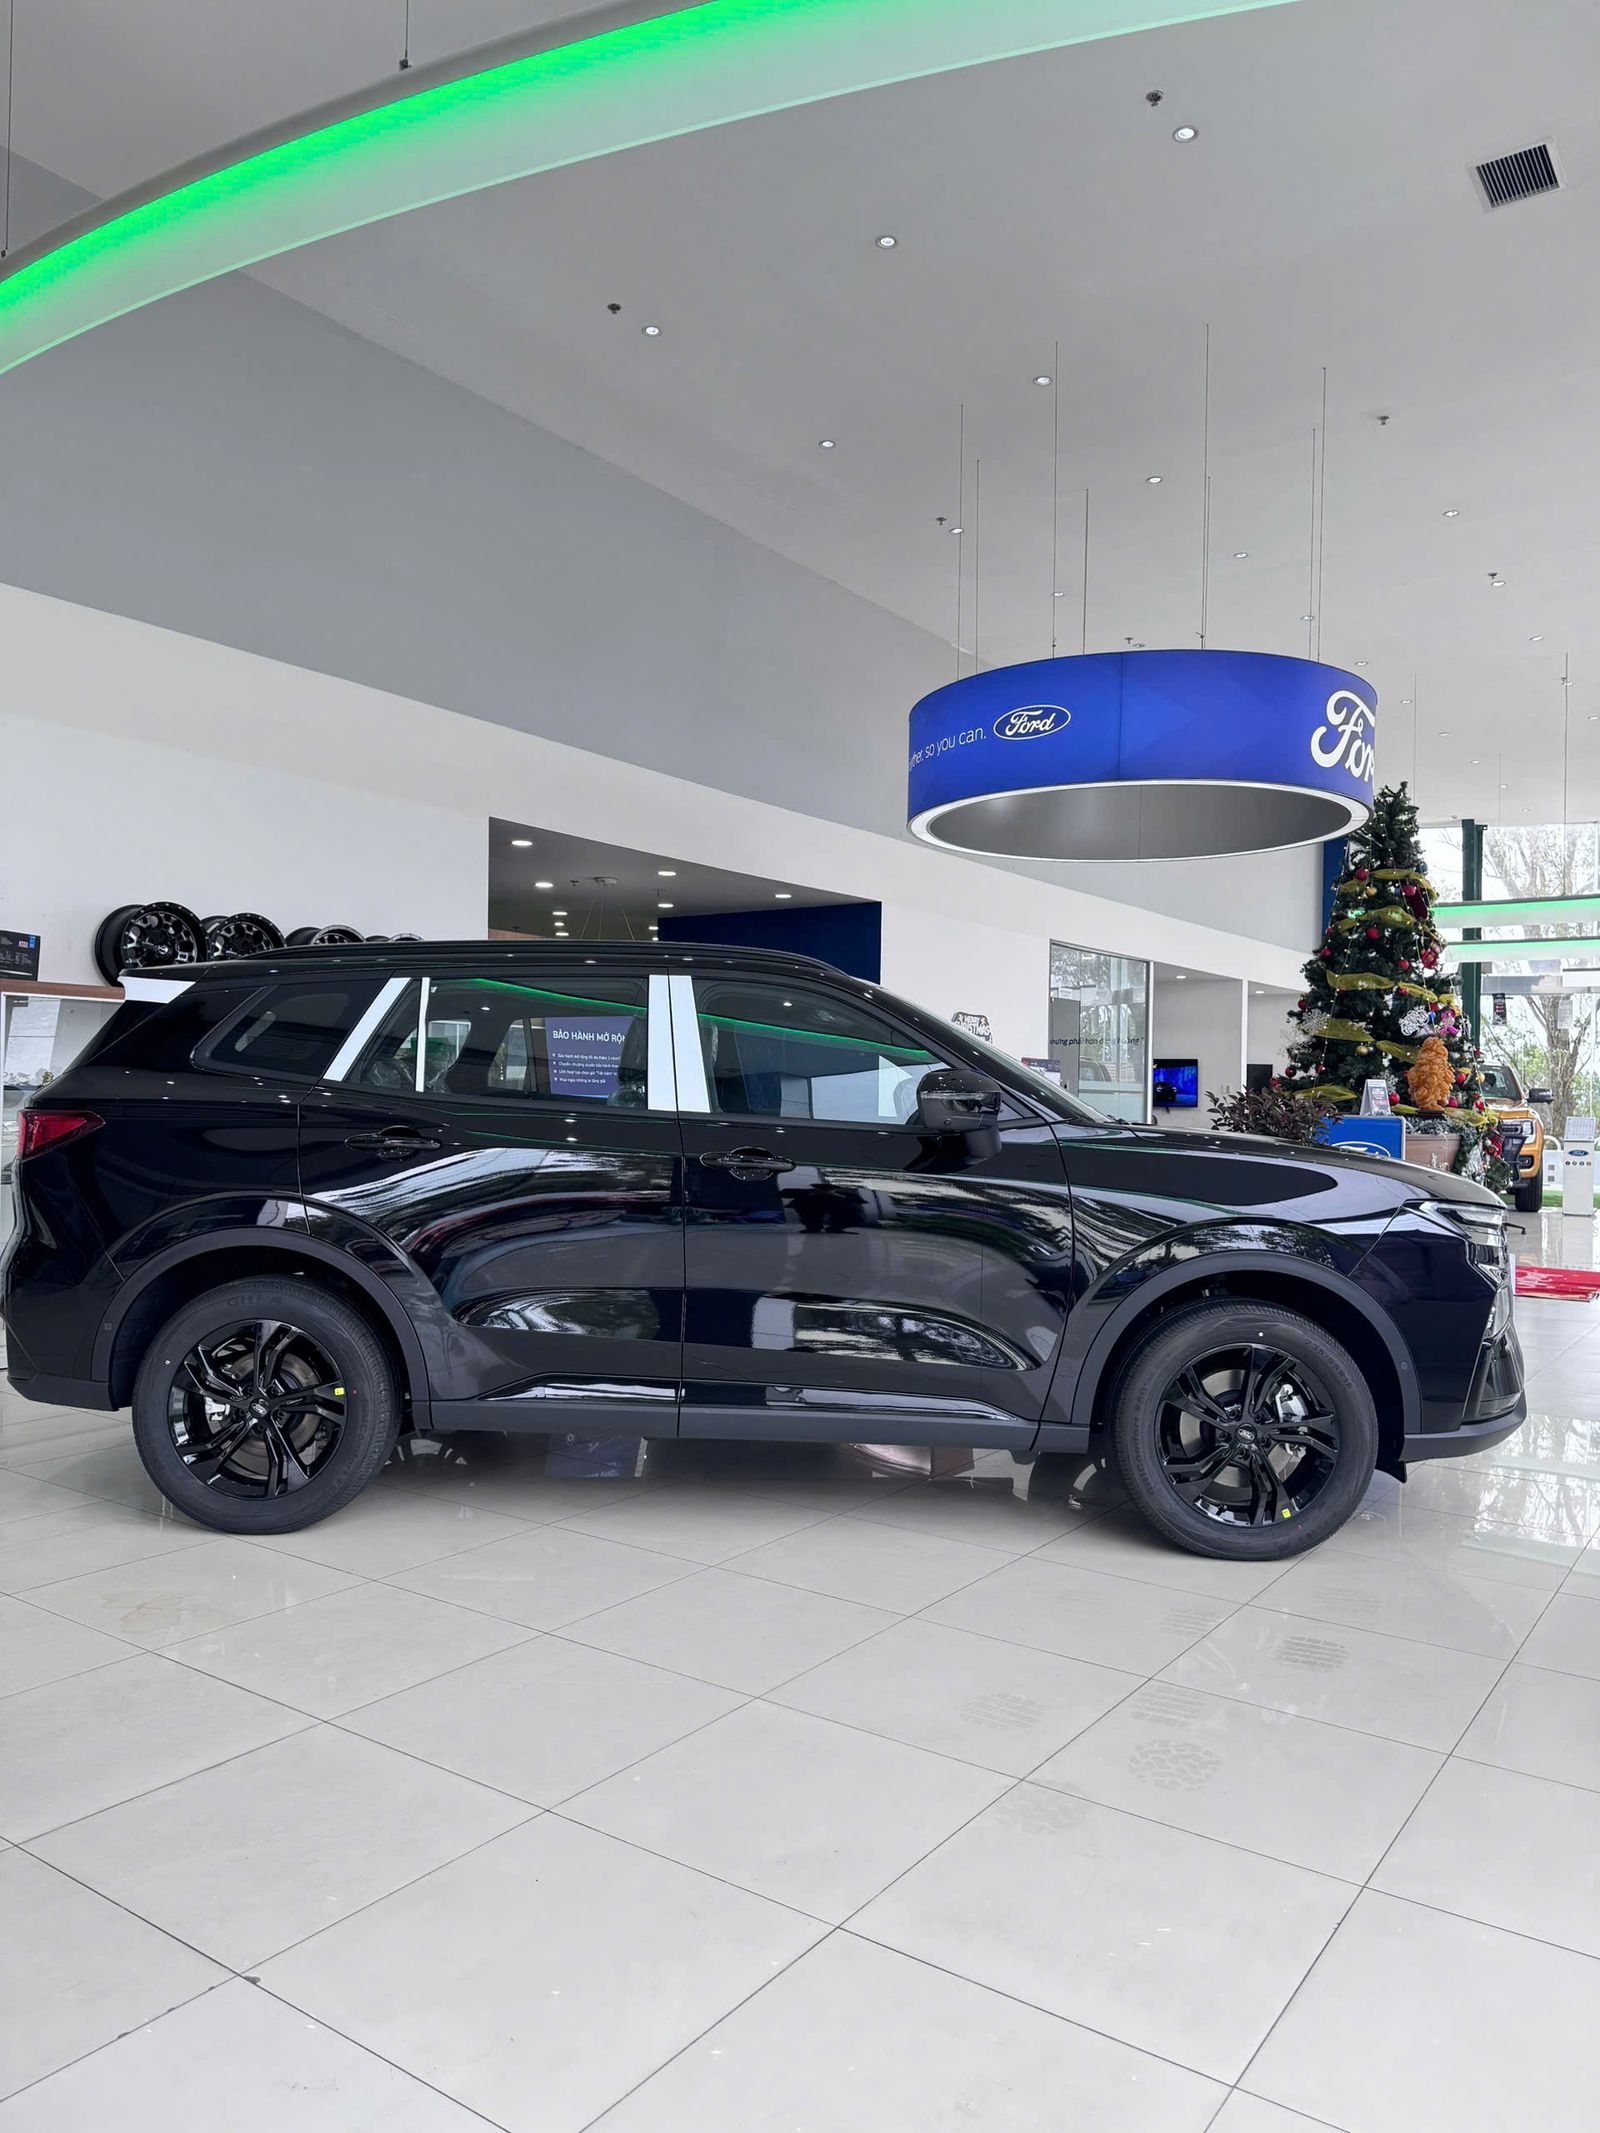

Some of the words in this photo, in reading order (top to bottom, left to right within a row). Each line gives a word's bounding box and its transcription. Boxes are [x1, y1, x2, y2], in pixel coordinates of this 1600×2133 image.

[925, 743, 936, 759] so
[936, 735, 956, 757] you
[958, 726, 987, 745] can.
[1005, 709, 1057, 736] Ford
[552, 1028, 570, 1040] BẢO
[571, 1030, 595, 1041] HÀNH
[596, 1031, 610, 1042] MỞ
